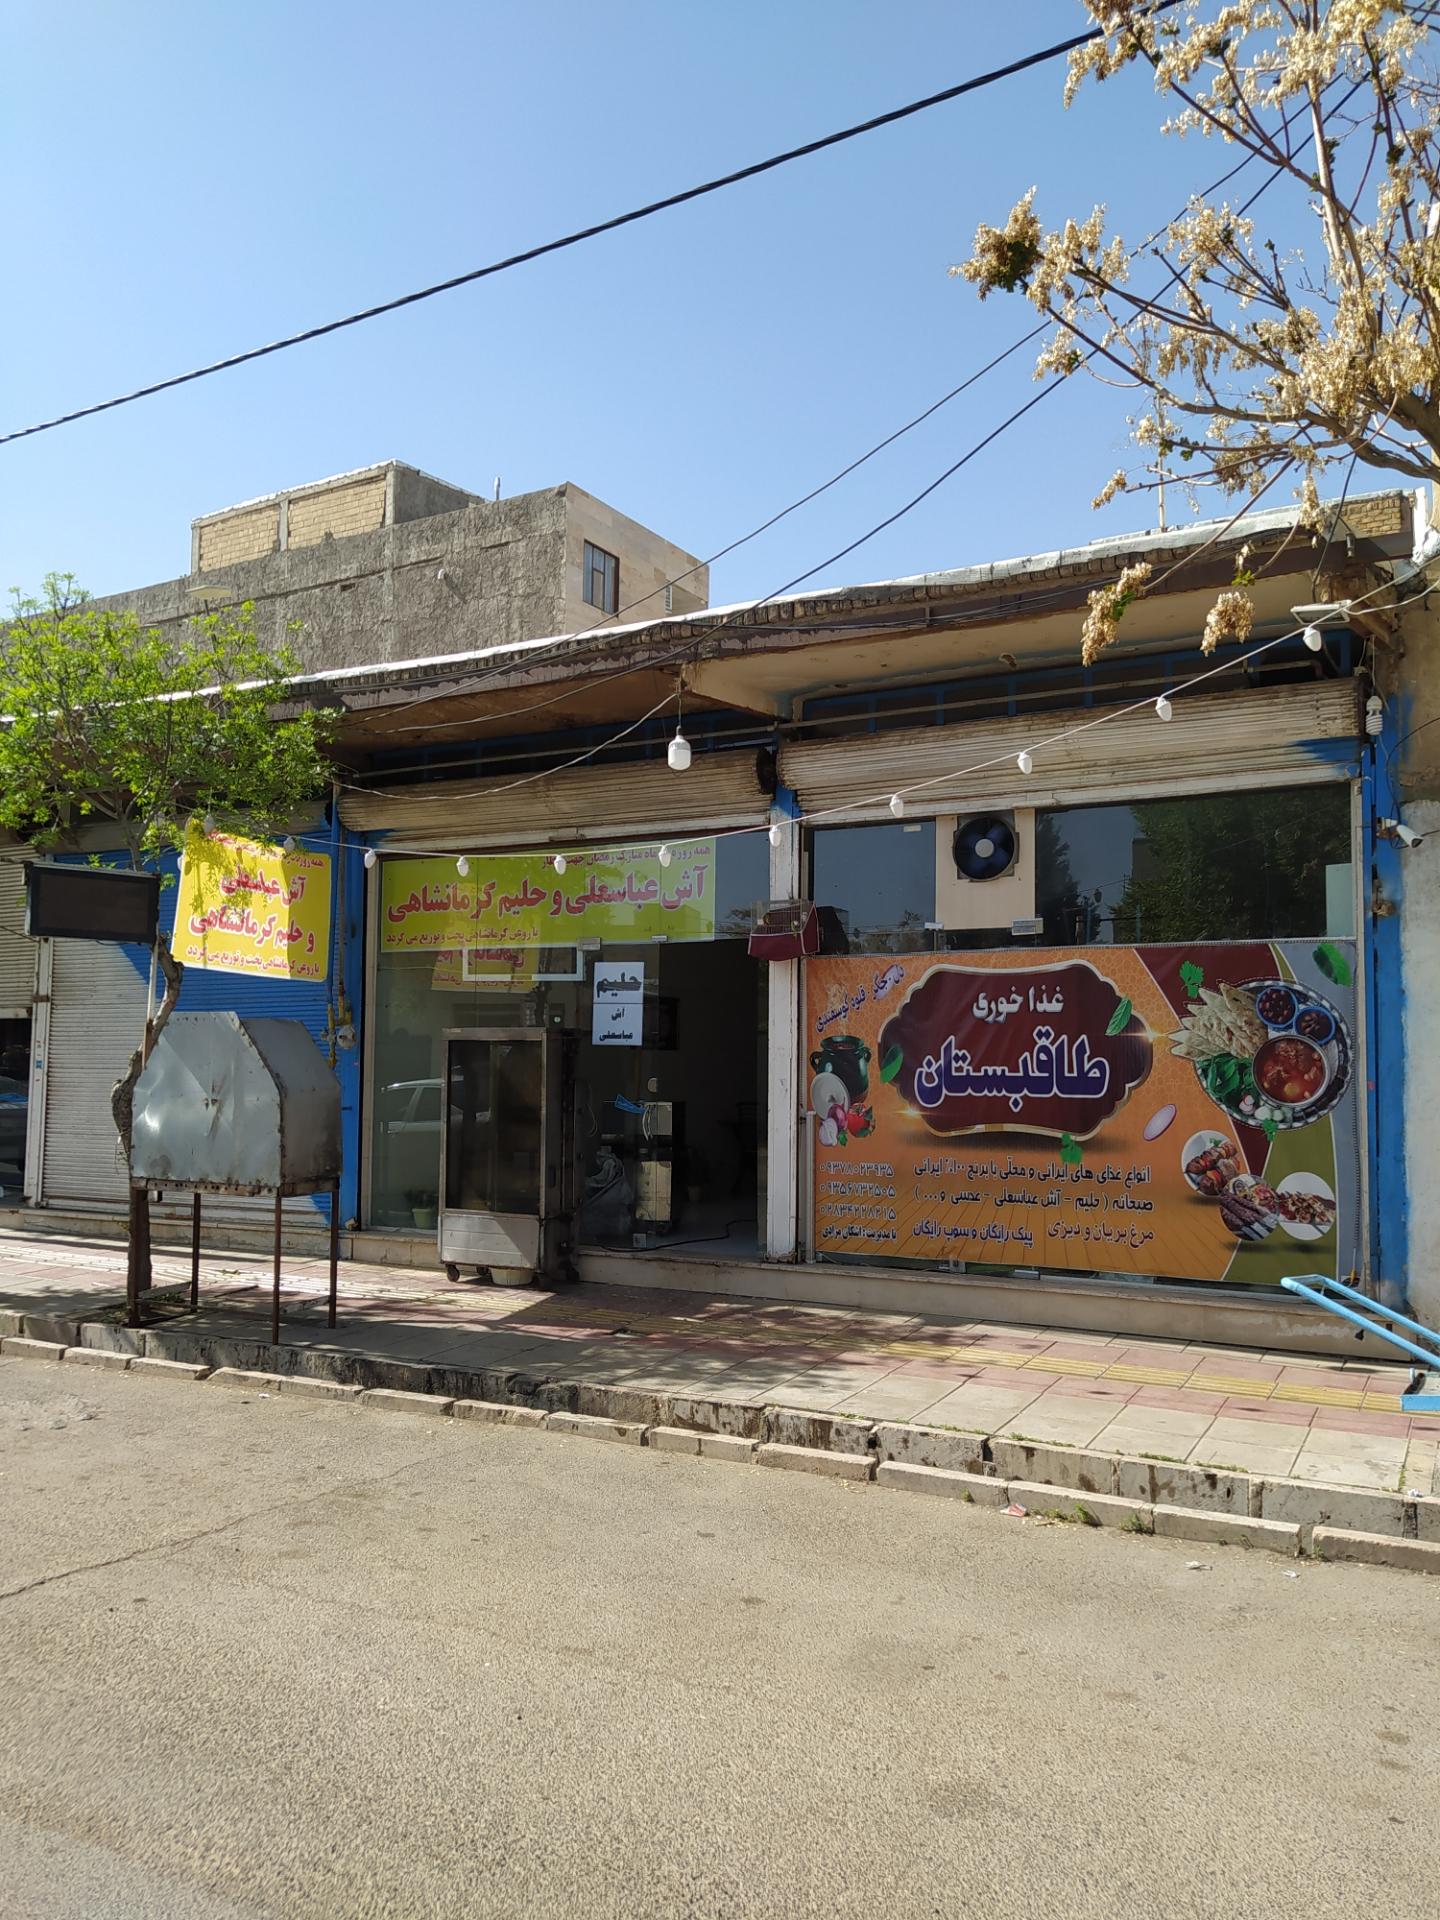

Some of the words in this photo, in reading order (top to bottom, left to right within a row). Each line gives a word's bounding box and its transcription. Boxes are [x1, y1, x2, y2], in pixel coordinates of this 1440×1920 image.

[220, 865, 280, 900] عباسعلی
[279, 876, 306, 905] آش
[661, 864, 709, 910] آش
[388, 879, 497, 923] کرمانشاهی
[498, 878, 547, 919] حلیم
[549, 889, 563, 916] و
[565, 872, 659, 916] عباسعلی
[189, 904, 277, 946] کرمانشاهی
[274, 920, 303, 947] حلیم
[307, 932, 315, 953] و
[596, 971, 642, 999] حلیم
[893, 964, 905, 985] دل
[973, 985, 1024, 1024] خوری
[1028, 984, 1065, 1014] غذا
[914, 1025, 1111, 1113] طاقبستان
[914, 1157, 943, 1177] ایرانی
[967, 1161, 989, 1181] برنج
[990, 1159, 998, 1178] با
[1028, 1167, 1035, 1179] و
[1038, 1162, 1068, 1183] ایرانی
[1071, 1164, 1094, 1183] های
[1096, 1164, 1122, 1184] غذای
[1124, 1165, 1151, 1188] انواع
[951, 1190, 981, 1205] عدسی
[994, 1187, 1038, 1209] عباسعلی
[1040, 1189, 1062, 1208] آش
[1075, 1192, 1100, 1212] حلیم
[1113, 1193, 1153, 1214] صبحانه
[891, 1227, 897, 1240] با
[913, 1217, 941, 1237] رایگان
[971, 1228, 977, 1240] و
[979, 1223, 1009, 1244] رایگان
[1011, 1225, 1034, 1249] پیک
[1047, 1219, 1080, 1240] دیزی
[1084, 1228, 1090, 1241] و
[1093, 1222, 1127, 1245] بریان
[1129, 1223, 1154, 1249] مرغ
